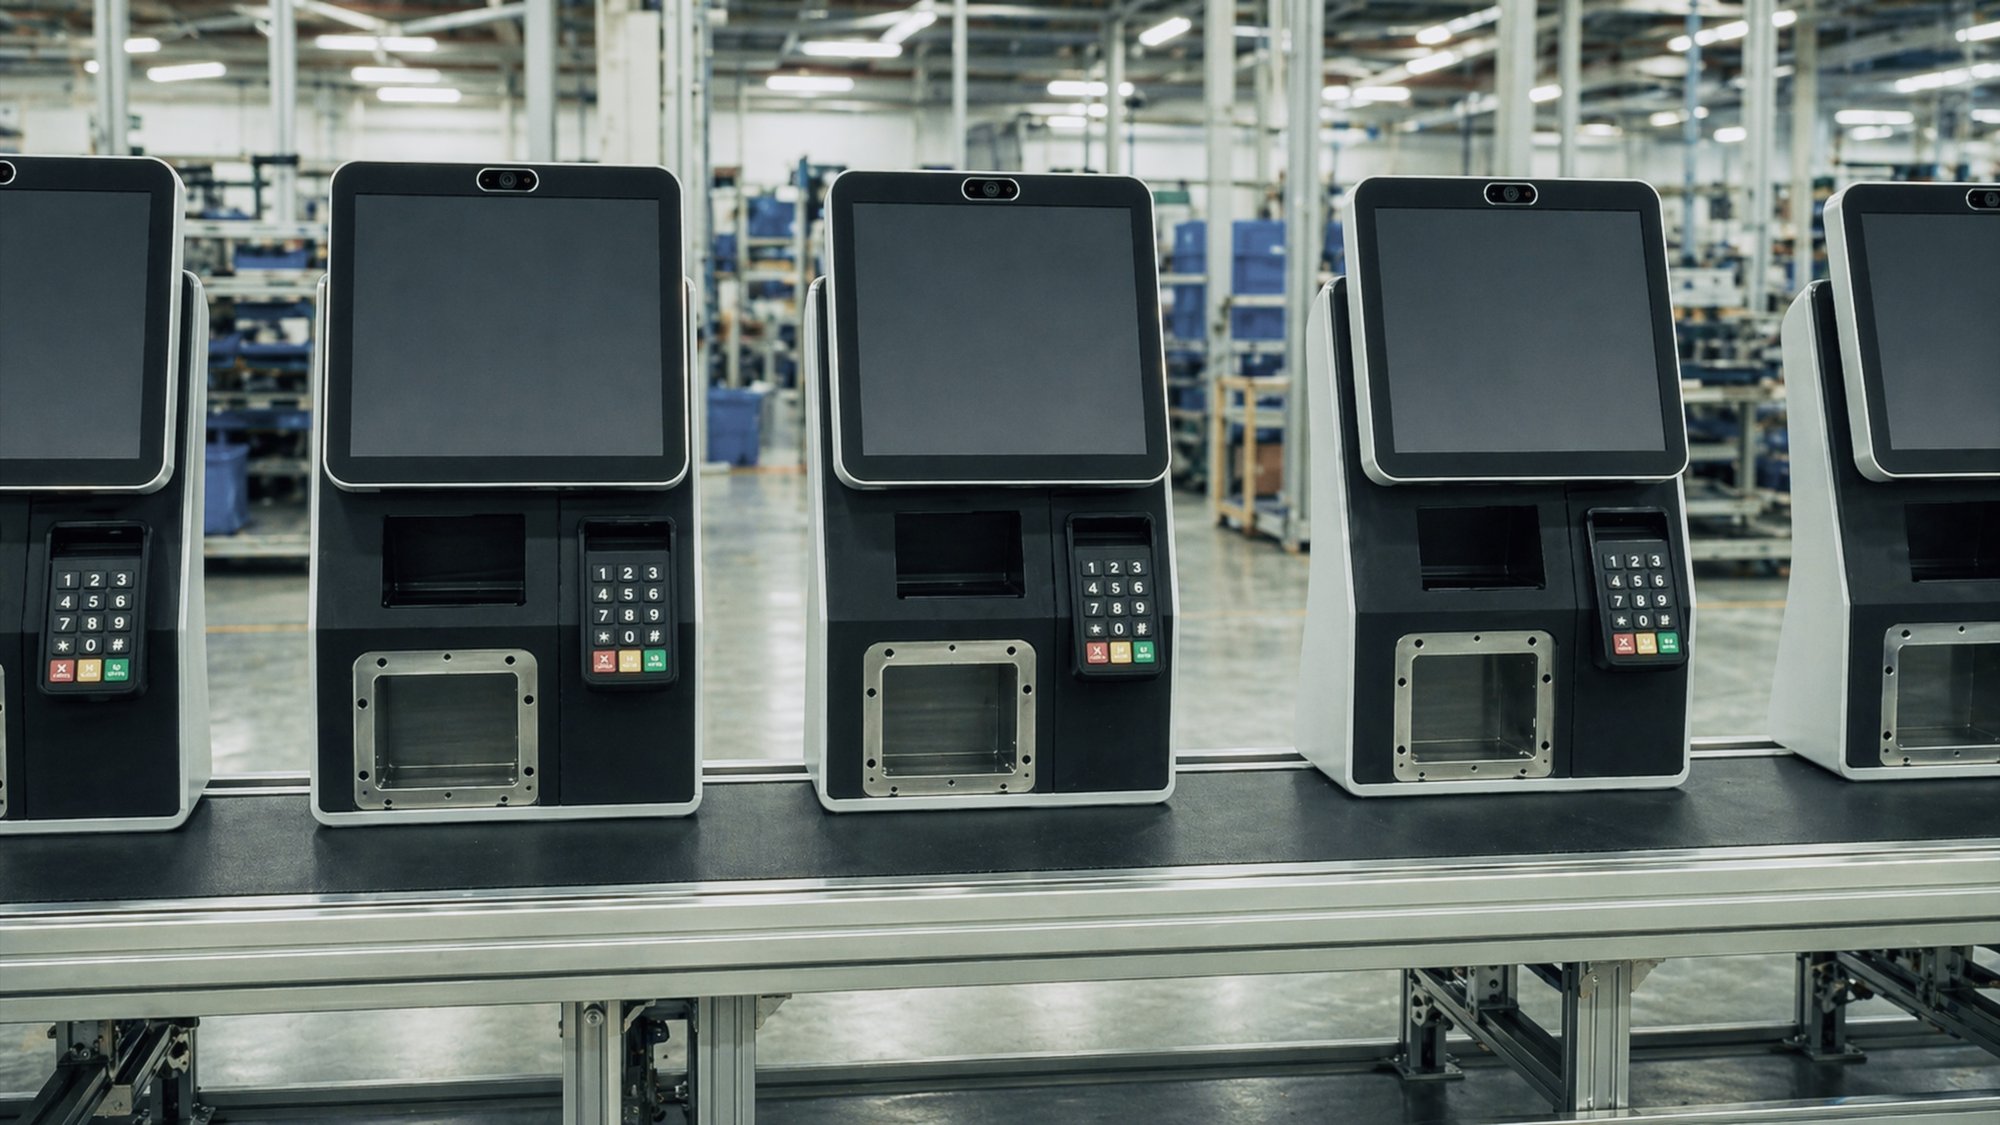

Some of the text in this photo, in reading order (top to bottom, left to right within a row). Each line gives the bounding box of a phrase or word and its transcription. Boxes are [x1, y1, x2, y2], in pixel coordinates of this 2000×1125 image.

[1087, 561, 1142, 574] 1 2 3
[1609, 554, 1661, 568] 1 2 3
[63, 572, 127, 587] 1 2 3
[598, 566, 659, 580] 1 2 3
[1612, 574, 1664, 586] 4 5 6
[598, 587, 659, 600] 4 5 6
[1089, 581, 1144, 594] 4 5 6
[61, 594, 126, 608] 4 5 6
[1614, 594, 1667, 606] 7 8 9
[1091, 601, 1146, 614] 7 8 9
[599, 608, 660, 621] 7 8 9
[1639, 614, 1649, 626] 0
[60, 616, 125, 630] 7 8 9
[1115, 622, 1124, 634] 0
[625, 630, 635, 643] 0
[86, 638, 97, 651] 0
